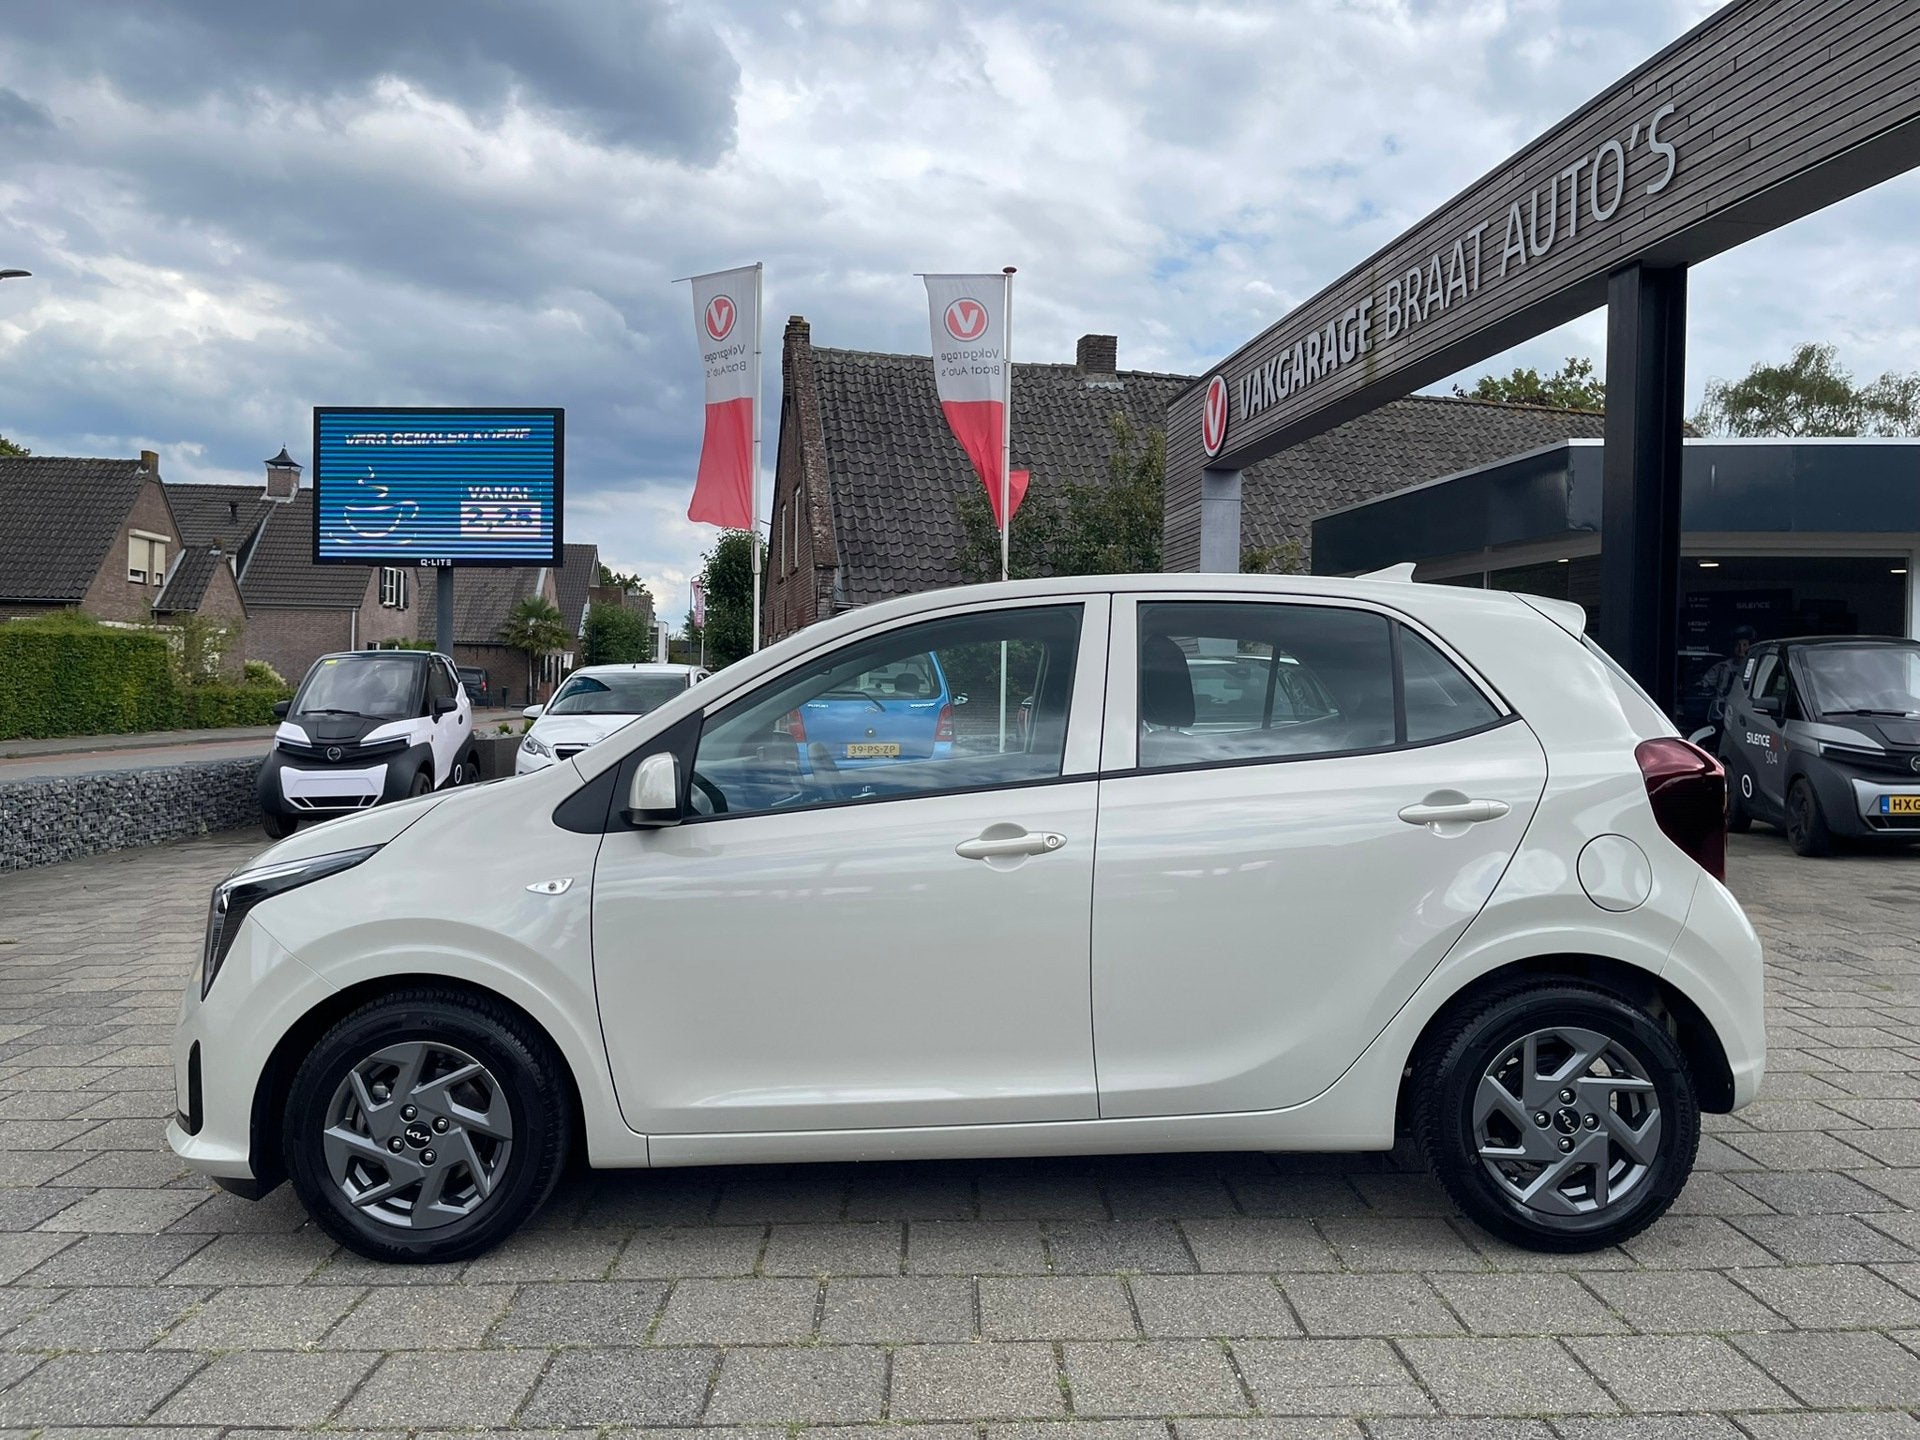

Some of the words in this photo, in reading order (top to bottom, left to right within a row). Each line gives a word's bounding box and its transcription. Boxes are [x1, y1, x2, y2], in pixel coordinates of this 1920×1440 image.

[1239, 297, 1374, 420] VAKGARAGE
[1385, 221, 1489, 341] BRAAT
[1500, 104, 1676, 277] AUTO'S
[1746, 731, 1770, 748] SILENCE
[850, 745, 896, 755] 39-PS-ZP
